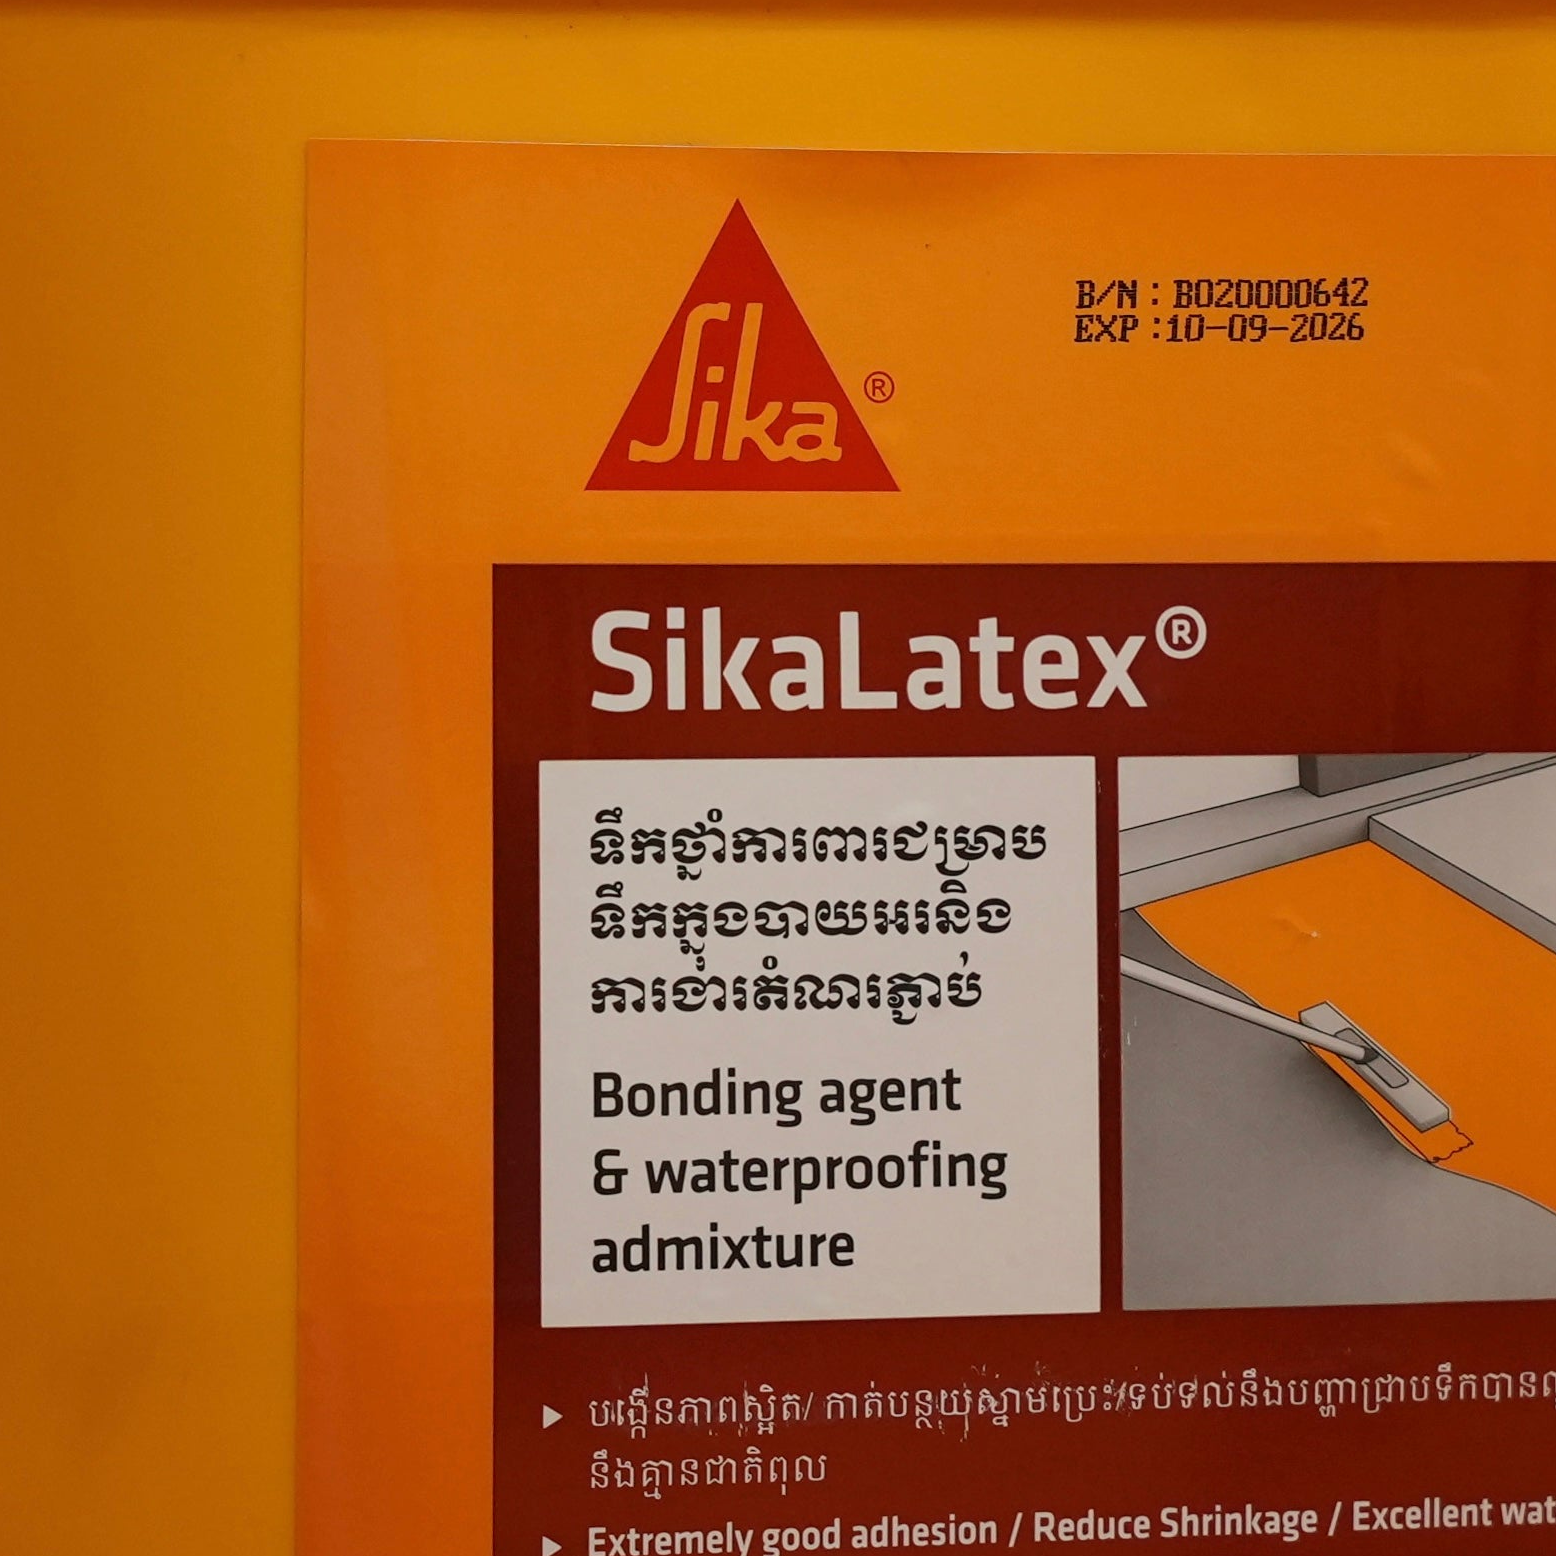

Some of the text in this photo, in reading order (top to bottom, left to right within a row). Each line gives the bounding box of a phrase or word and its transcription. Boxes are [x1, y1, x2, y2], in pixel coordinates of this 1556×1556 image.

[1075, 279, 1138, 309] B/N
[1074, 314, 1139, 342] EXP
[593, 1067, 962, 1128] Bonding agent
[593, 1140, 1008, 1205] & waterproofing
[592, 1222, 855, 1274] admixture
[851, 1513, 997, 1549] adhesion
[1034, 1508, 1151, 1542] Reduce
[1160, 1503, 1318, 1543] Shrinkage
[1352, 1496, 1493, 1531] Excellent
